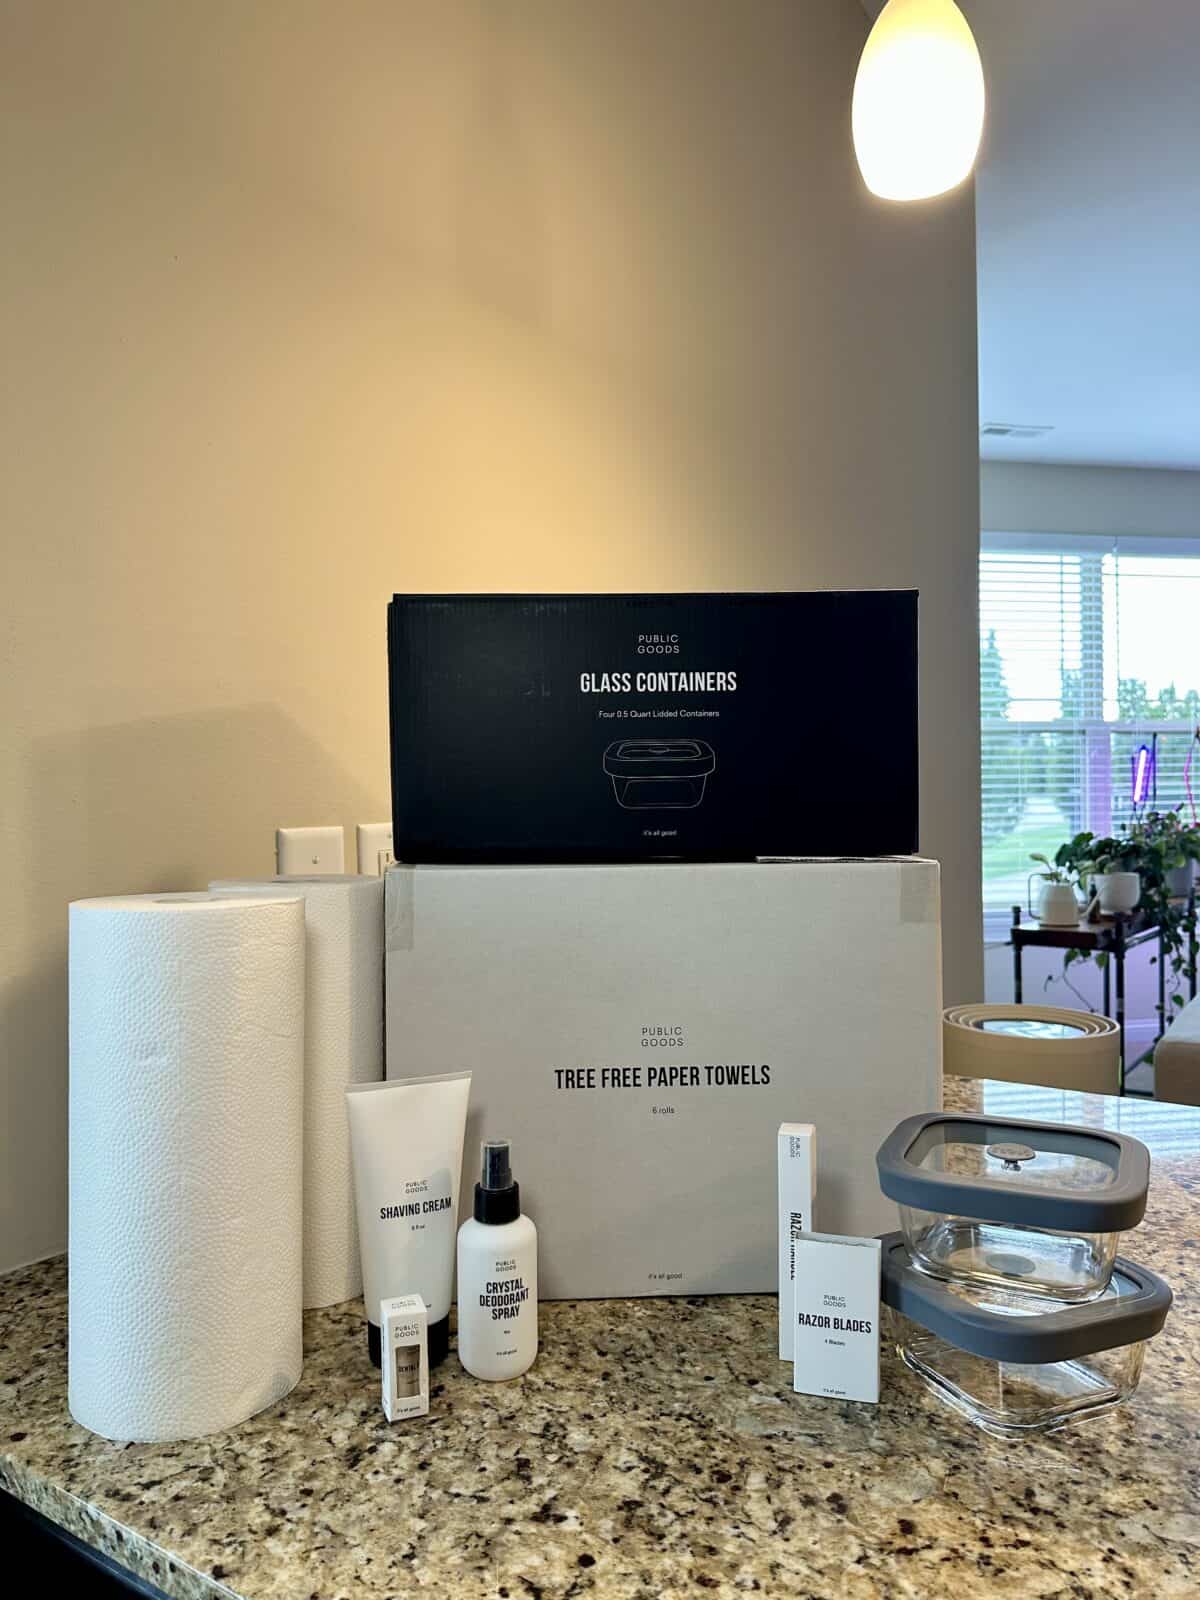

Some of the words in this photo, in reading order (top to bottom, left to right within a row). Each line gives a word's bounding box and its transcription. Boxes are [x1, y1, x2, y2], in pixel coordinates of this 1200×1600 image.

[638, 634, 679, 643] PUBLIC
[637, 645, 680, 654] GOODS
[580, 672, 631, 693] GLASS
[636, 671, 737, 692] CONTAINERS
[599, 710, 615, 718] Four
[617, 710, 628, 718] 0.5
[630, 710, 651, 718] Quart
[653, 709, 678, 718] Lidded
[680, 709, 720, 718] Containers
[642, 1027, 682, 1036] PUBLIC
[641, 1038, 684, 1047] GOODS
[555, 1069, 596, 1089] TREE
[601, 1067, 642, 1088] FREE
[648, 1066, 700, 1087] PAPER
[704, 1065, 771, 1086] TOWELS
[659, 1106, 675, 1114] rolls
[405, 1179, 428, 1188] PUBLIC
[405, 1186, 429, 1194] GOODS
[380, 1202, 420, 1219] SHAVING
[422, 1196, 452, 1213] CREAM
[486, 1277, 524, 1294] CRYSTAL
[479, 1287, 529, 1307] DEODORANT
[823, 1294, 846, 1302] PUBLIC
[823, 1300, 847, 1308] GOODS
[491, 1304, 520, 1320] SPRAY
[394, 1323, 419, 1332] PUBLIC
[798, 1312, 830, 1329] RAZOR
[833, 1317, 872, 1334] BLADES
[394, 1330, 420, 1338] GOODS
